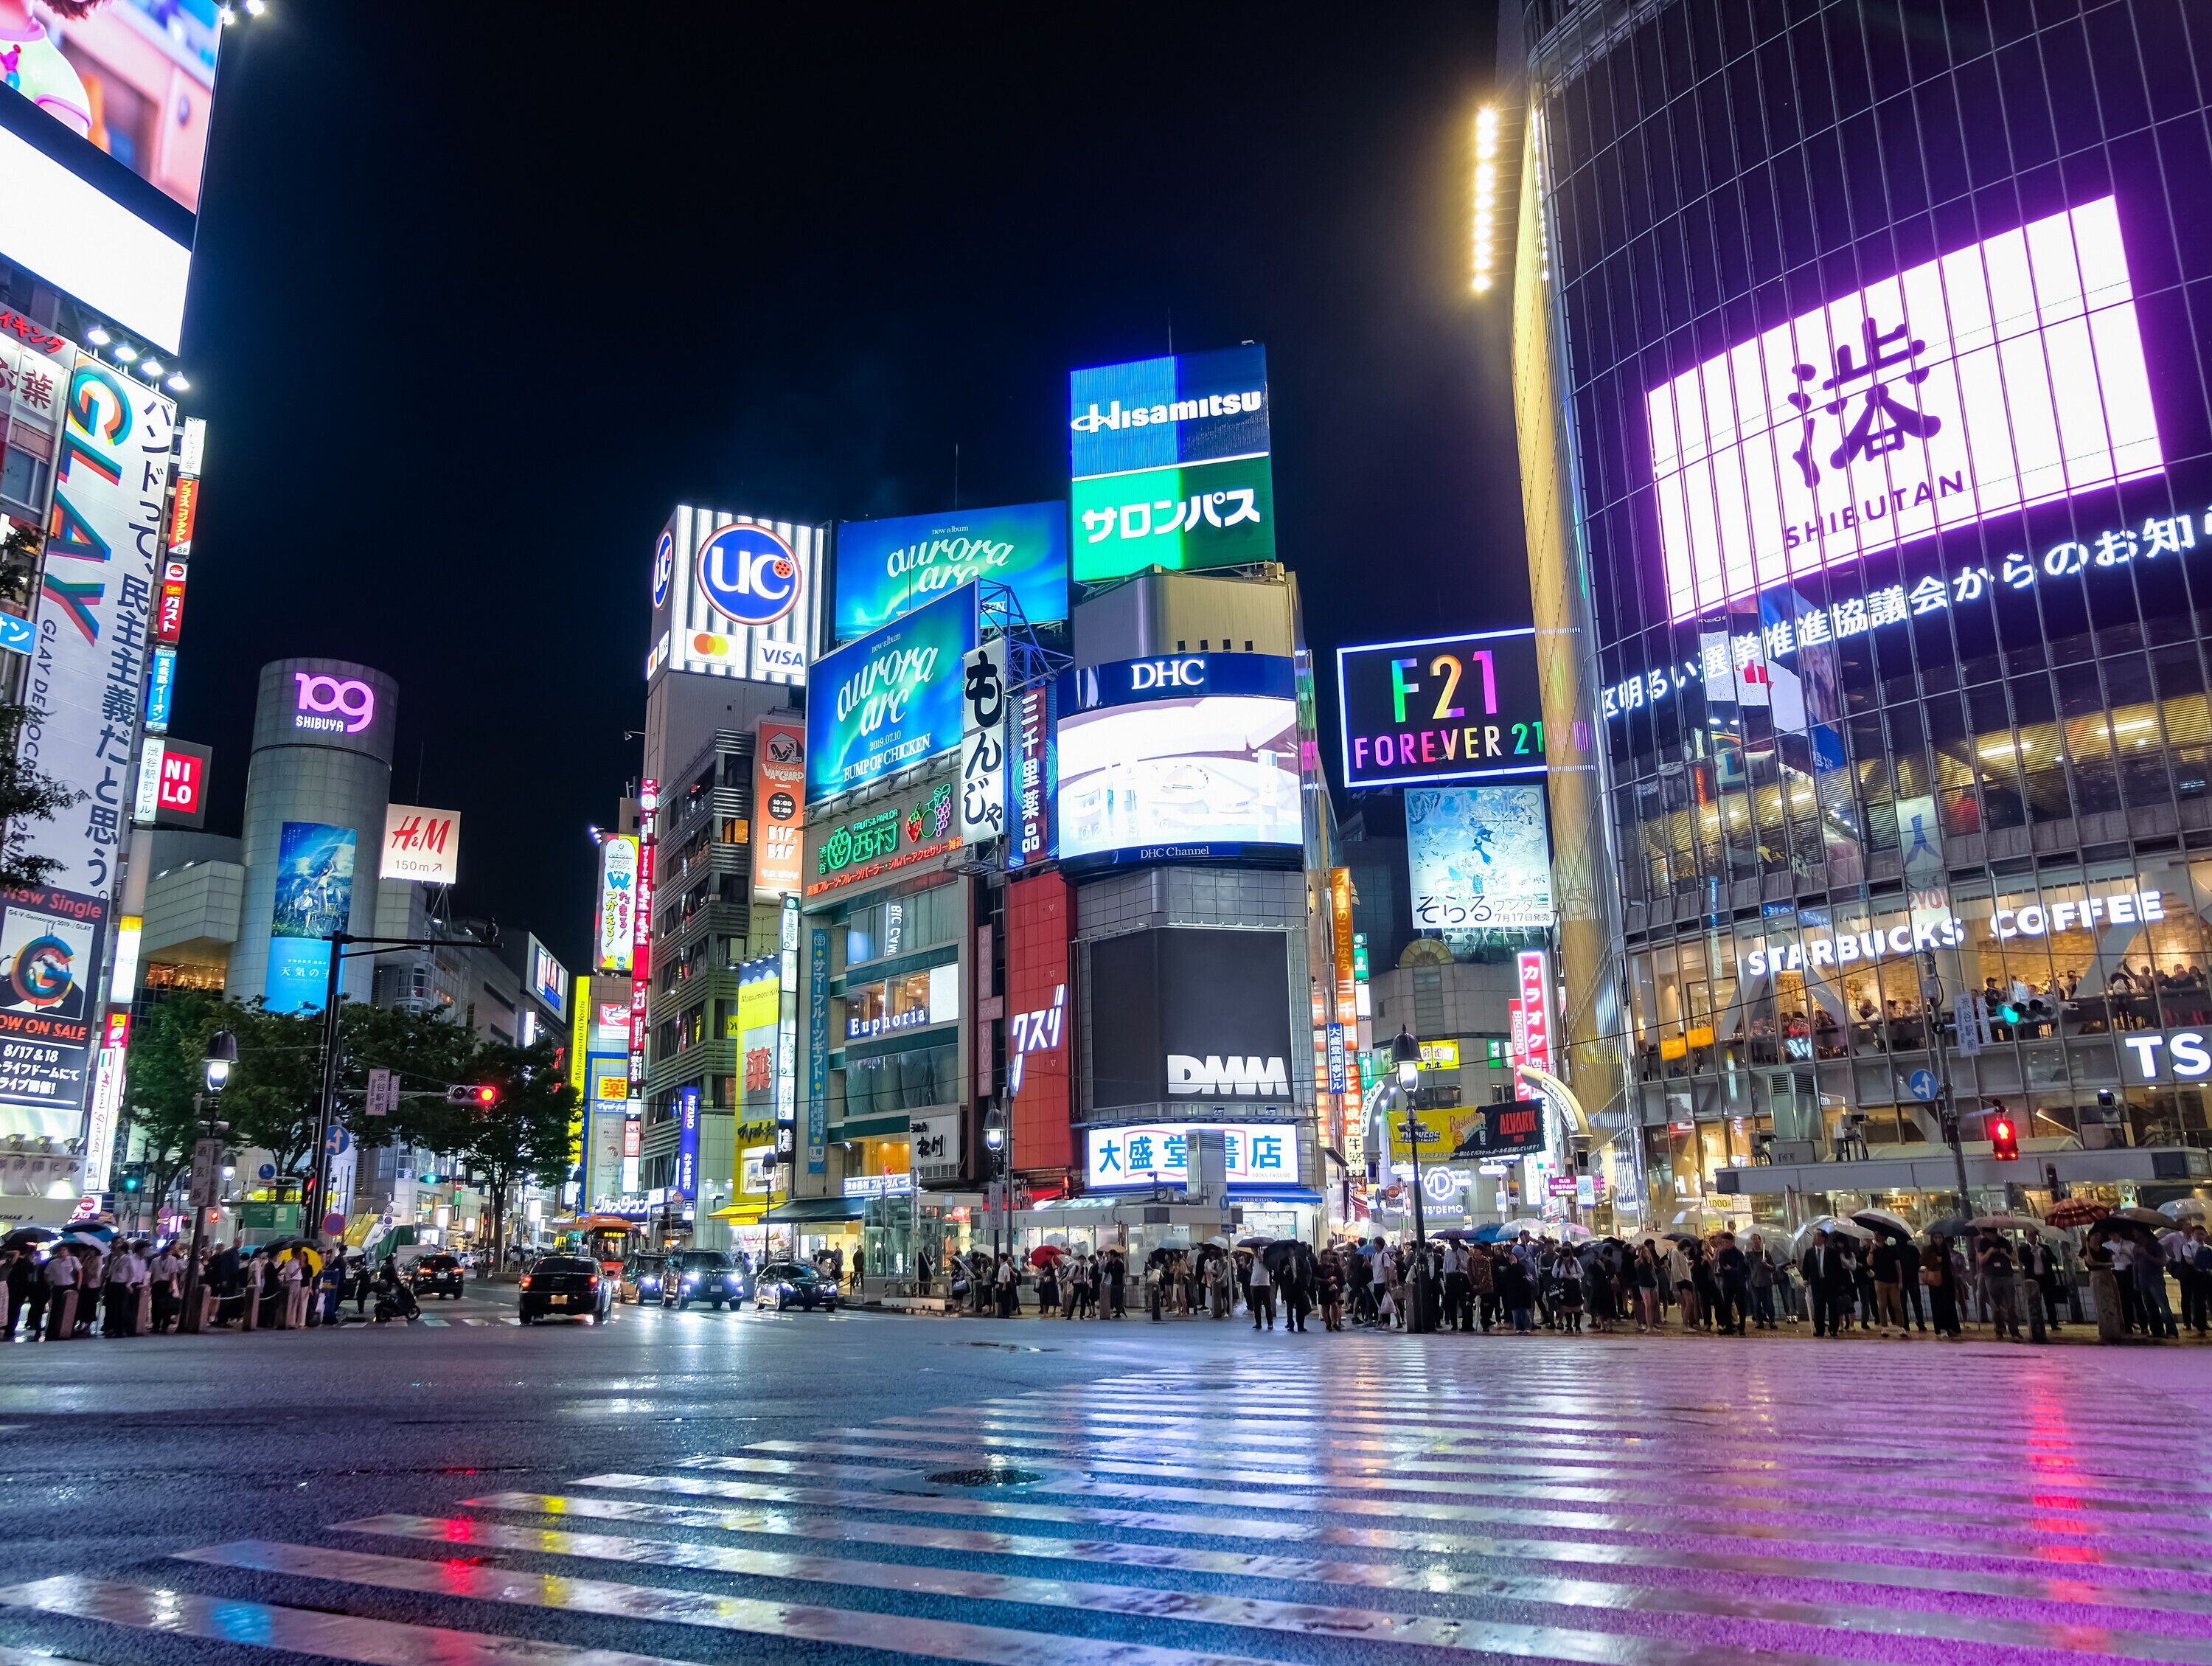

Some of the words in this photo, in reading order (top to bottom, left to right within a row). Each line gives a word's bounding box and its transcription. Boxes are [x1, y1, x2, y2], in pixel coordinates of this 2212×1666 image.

[1071, 391, 1262, 434] Hisamitsu
[932, 527, 945, 535] new
[947, 525, 969, 534] album
[1081, 488, 1260, 544] サロンパス
[1787, 470, 1964, 549] SHIBUTAN
[711, 546, 791, 600] UC
[886, 536, 1015, 578] aurora
[919, 565, 980, 593] arc
[162, 596, 181, 633] ガスト
[1601, 501, 2212, 721] 区明るい選挙推進協議会からのお知
[37, 618, 57, 676] GLAY
[761, 648, 804, 667] VISA
[871, 642, 883, 654] new
[883, 632, 901, 648] album
[837, 645, 939, 723] aurora
[1130, 659, 1205, 690] DHC
[1391, 649, 1498, 723] F21
[295, 672, 375, 733] 109
[860, 688, 909, 738] arc
[296, 715, 344, 733] SHIBUYA
[869, 732, 902, 752] 2019.07.10
[965, 650, 1003, 832] もんじゃ
[1354, 724, 1503, 769] FOREVER
[1511, 720, 1545, 755] 21
[165, 758, 190, 779] NI
[762, 763, 804, 782] VANGUARD
[843, 760, 870, 784] BUMP
[870, 754, 883, 771] OF
[883, 732, 932, 765] CHICKEN
[1022, 693, 1040, 854] 三千里薬品
[139, 746, 159, 815] 渋谷駅前ビル
[162, 785, 192, 805] LO
[392, 815, 452, 855] H&M
[852, 821, 899, 864] 西村
[1140, 848, 1165, 859] DHC
[1166, 846, 1210, 858] Channel
[49, 893, 103, 919] Single
[1335, 872, 1350, 971] クスリのことなら
[1416, 895, 1492, 924] そらる
[1494, 912, 1551, 923] 7月17日発売
[1749, 916, 1965, 976] STARBUCKS
[1989, 890, 2166, 940] COFFEE
[741, 989, 769, 1002] Matsumoto
[1523, 965, 1546, 1049] カラオケ
[25, 1019, 51, 1035] ON
[53, 1024, 87, 1041] SALE
[812, 959, 826, 1080] サマーフルーツギフト
[850, 1006, 927, 1036] Euphoria
[1012, 983, 1067, 1094] クスリ
[1512, 1010, 1523, 1031] BIG
[1961, 997, 1977, 1051] 渋谷駅前
[1329, 1027, 1343, 1091] 大盛堂商事ビル
[1514, 1032, 1526, 1055] ECHO
[2124, 1032, 2212, 1079] TS
[0, 1061, 81, 1082] ライフドームにて
[603, 1079, 625, 1098] 薬
[745, 1046, 772, 1092] 薬
[1167, 1054, 1290, 1096] DMM
[686, 1094, 696, 1129] MIZUHO
[1500, 1110, 1537, 1136] ALVARK
[682, 1153, 692, 1190] みずほ銀行
[594, 1194, 649, 1214] グルメタウン
